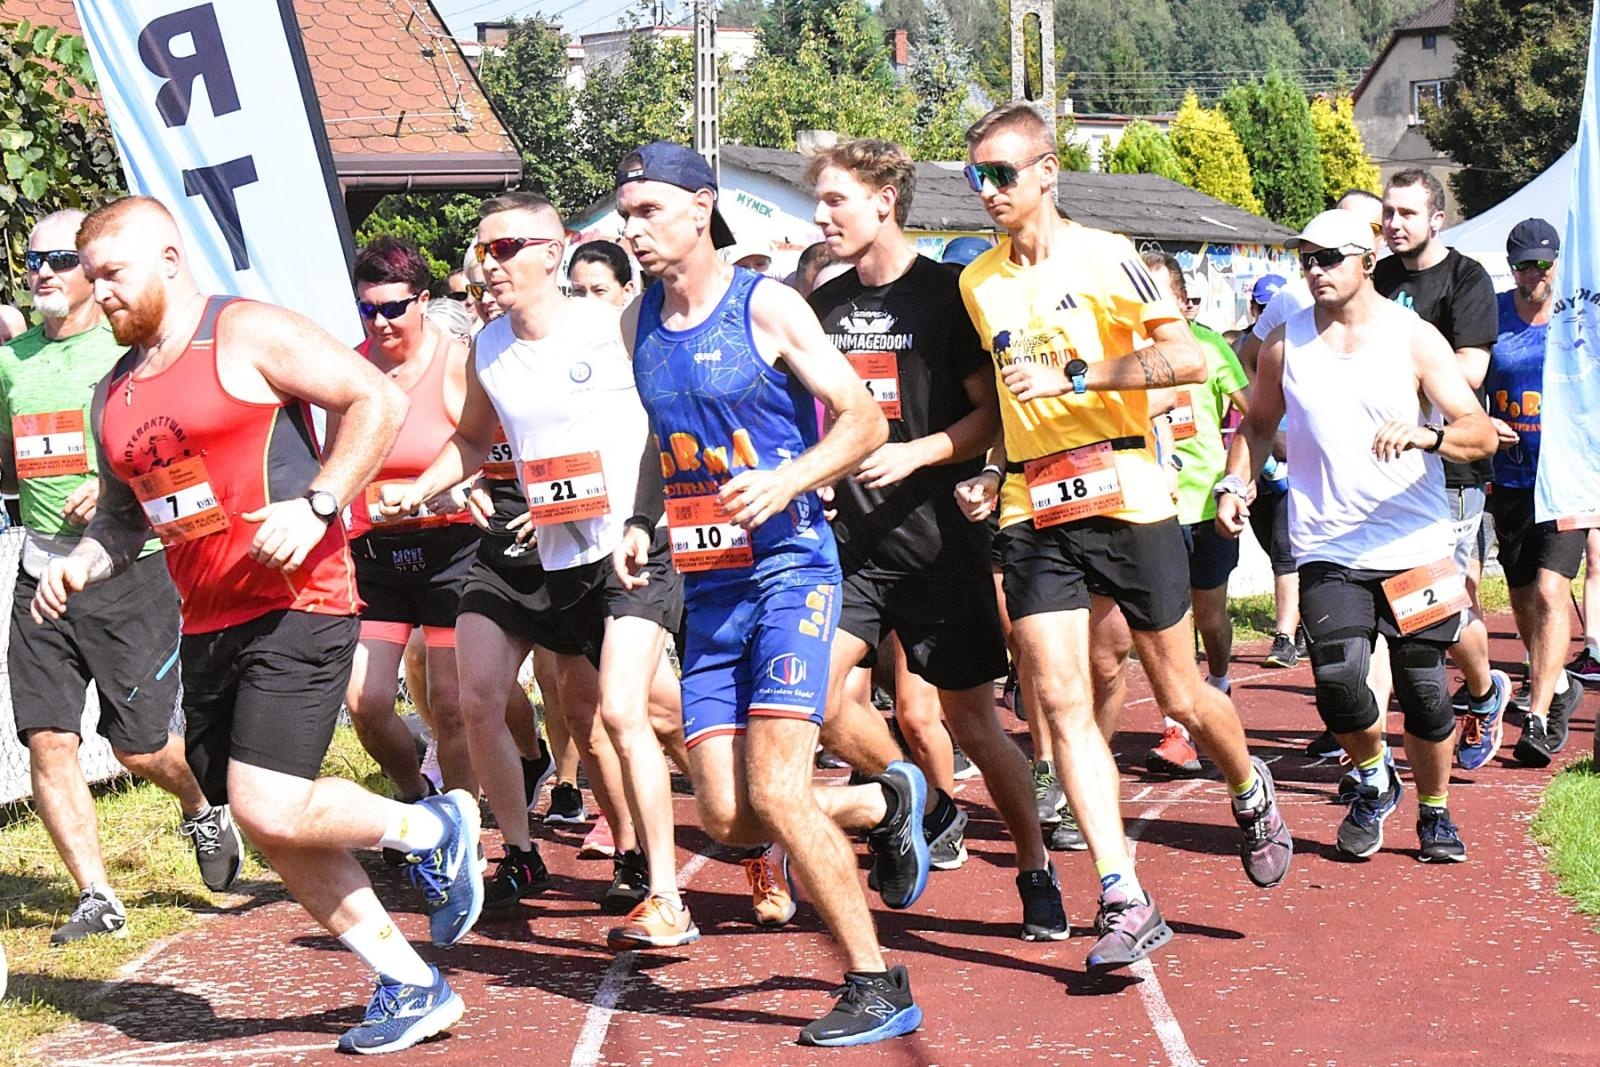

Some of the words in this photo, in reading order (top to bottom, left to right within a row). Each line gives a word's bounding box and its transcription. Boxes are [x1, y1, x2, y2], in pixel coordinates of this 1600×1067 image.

[43, 437, 53, 455] 1
[491, 443, 512, 461] 59
[550, 480, 577, 502] 21
[1057, 478, 1088, 502] 18
[166, 495, 178, 518] 7
[695, 526, 722, 550] 10
[1423, 589, 1439, 606] 2
